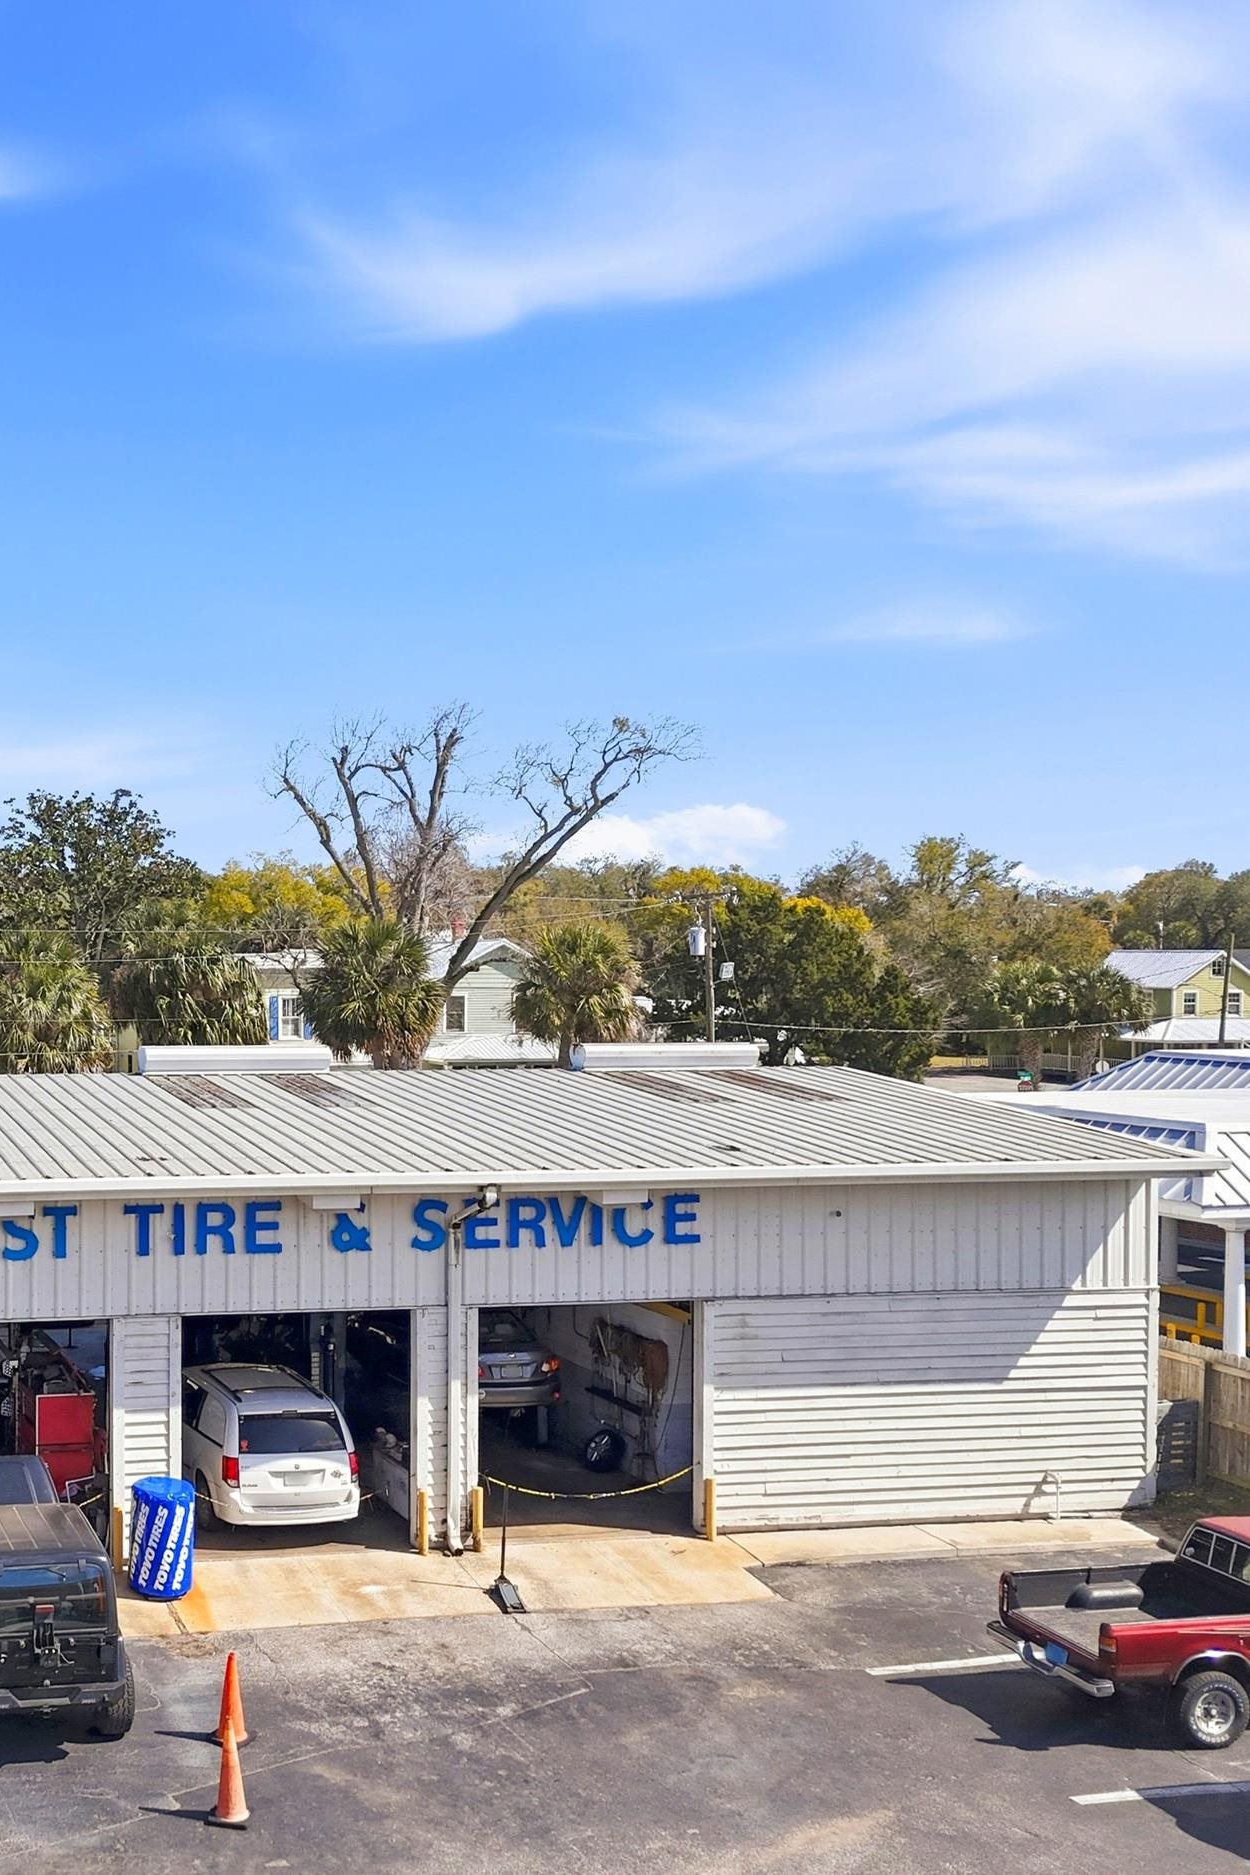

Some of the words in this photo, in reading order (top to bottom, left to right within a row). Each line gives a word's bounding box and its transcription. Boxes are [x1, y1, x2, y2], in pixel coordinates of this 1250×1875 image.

[124, 1202, 282, 1256] TIRE
[331, 1202, 372, 1253] &
[411, 1193, 700, 1252] SERVICE
[138, 1547, 155, 1588] TOYO
[148, 1505, 169, 1550] TIRES
[153, 1548, 174, 1591] TOYO
[172, 1545, 189, 1591] TOYO
